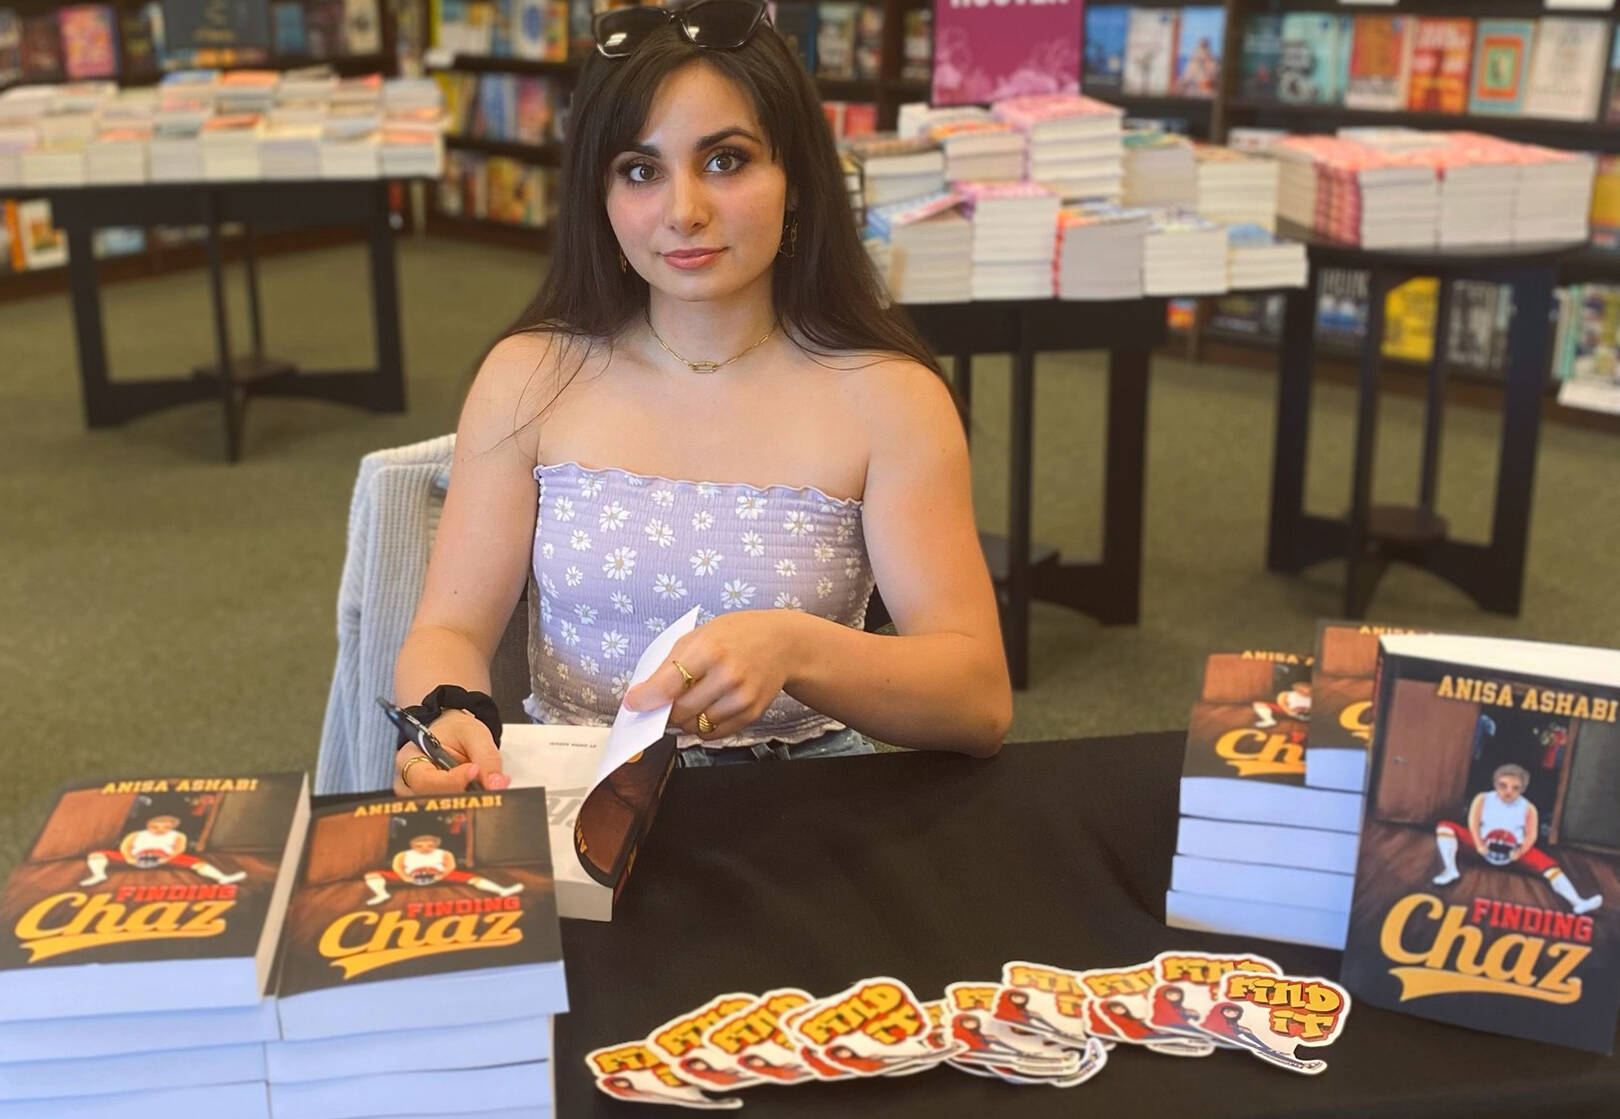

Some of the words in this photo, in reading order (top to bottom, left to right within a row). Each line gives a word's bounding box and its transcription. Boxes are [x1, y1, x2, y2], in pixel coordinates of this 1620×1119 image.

[1241, 650, 1299, 665] ANISA
[1437, 675, 1514, 707] ANISA
[1521, 688, 1619, 723] ASHABI
[1215, 728, 1306, 776] Ch
[102, 779, 169, 795] ANISA
[176, 778, 259, 792] ASHABI
[353, 800, 418, 818] ANISA
[424, 795, 503, 812] ASHABI
[116, 884, 238, 903] FINDING
[407, 895, 521, 920] FINDING
[14, 892, 237, 964] Chaz
[1471, 897, 1594, 942] FINDING
[318, 910, 524, 980] Chaz
[1380, 893, 1593, 1004] Chaz
